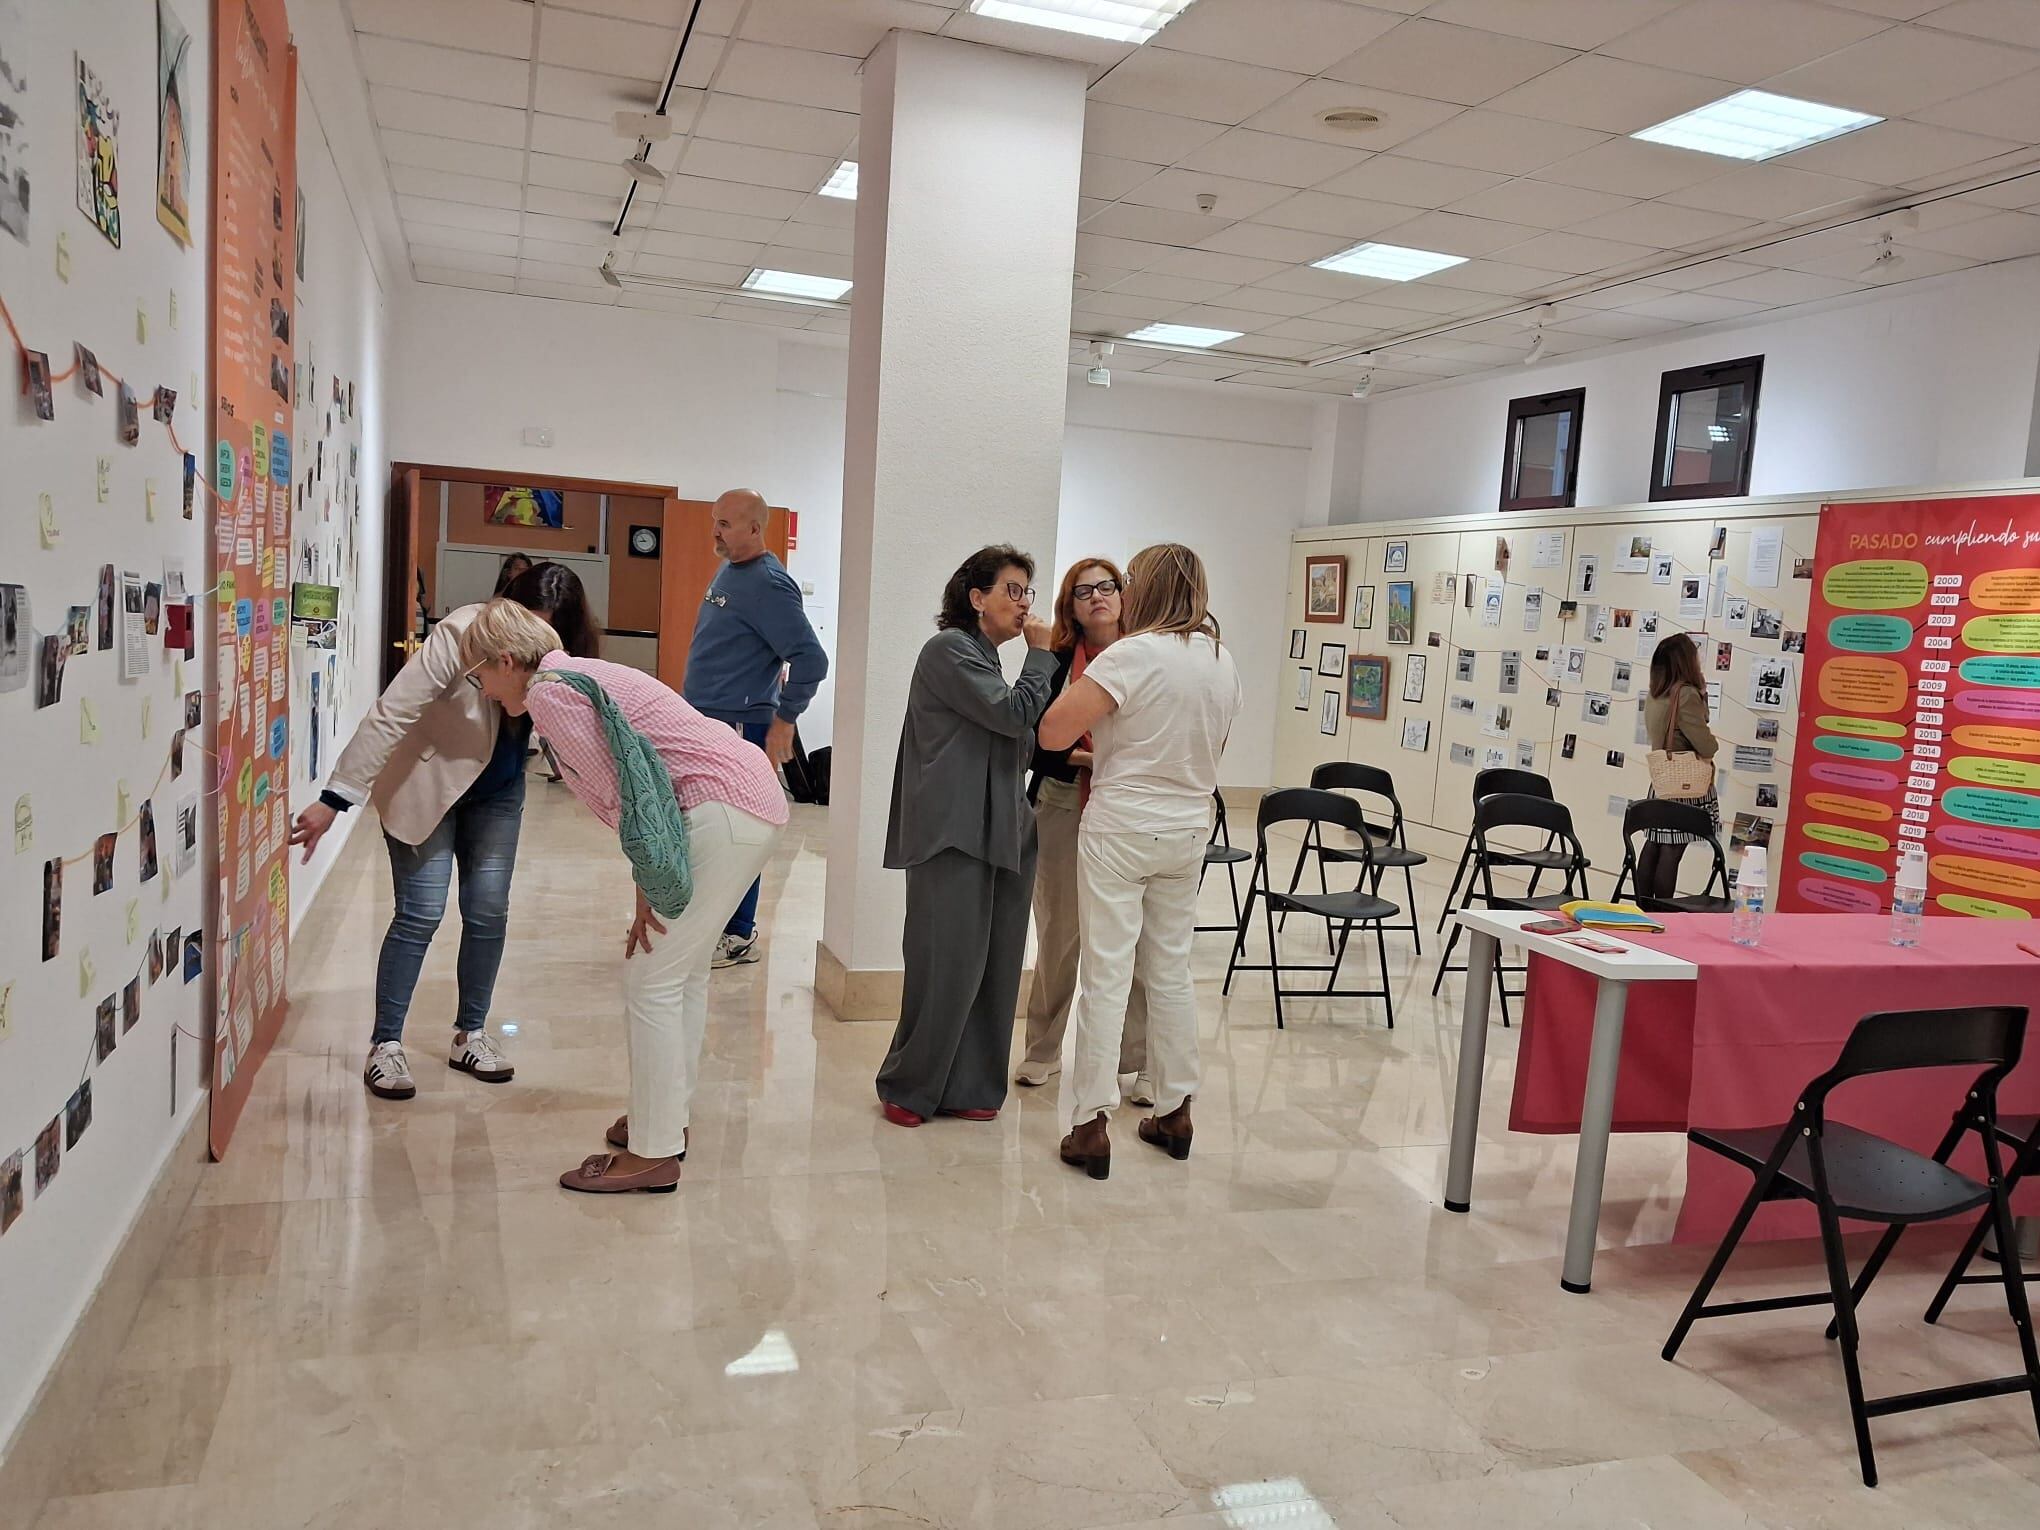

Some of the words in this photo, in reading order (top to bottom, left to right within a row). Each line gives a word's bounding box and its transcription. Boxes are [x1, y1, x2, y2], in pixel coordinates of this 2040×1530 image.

[1850, 533, 1918, 549] PASADO
[1925, 518, 2020, 556] cumpliendo
[1937, 577, 1959, 585] 2000
[1935, 596, 1955, 604] 2001
[1931, 616, 1952, 625] 2003
[1927, 638, 1948, 647] 2004
[1924, 662, 1946, 671] 2008
[1921, 681, 1943, 690] 2009
[1920, 697, 1940, 707] 2010
[1920, 713, 1938, 723] 2011
[1919, 730, 1937, 739] 2013
[1917, 746, 1936, 755] 2014
[1915, 762, 1934, 771] 2015
[1911, 778, 1931, 788] 2016
[1909, 794, 1928, 804] 2017
[1906, 810, 1925, 820] 2018
[1903, 826, 1922, 836] 2019
[1901, 842, 1921, 852] 2020
